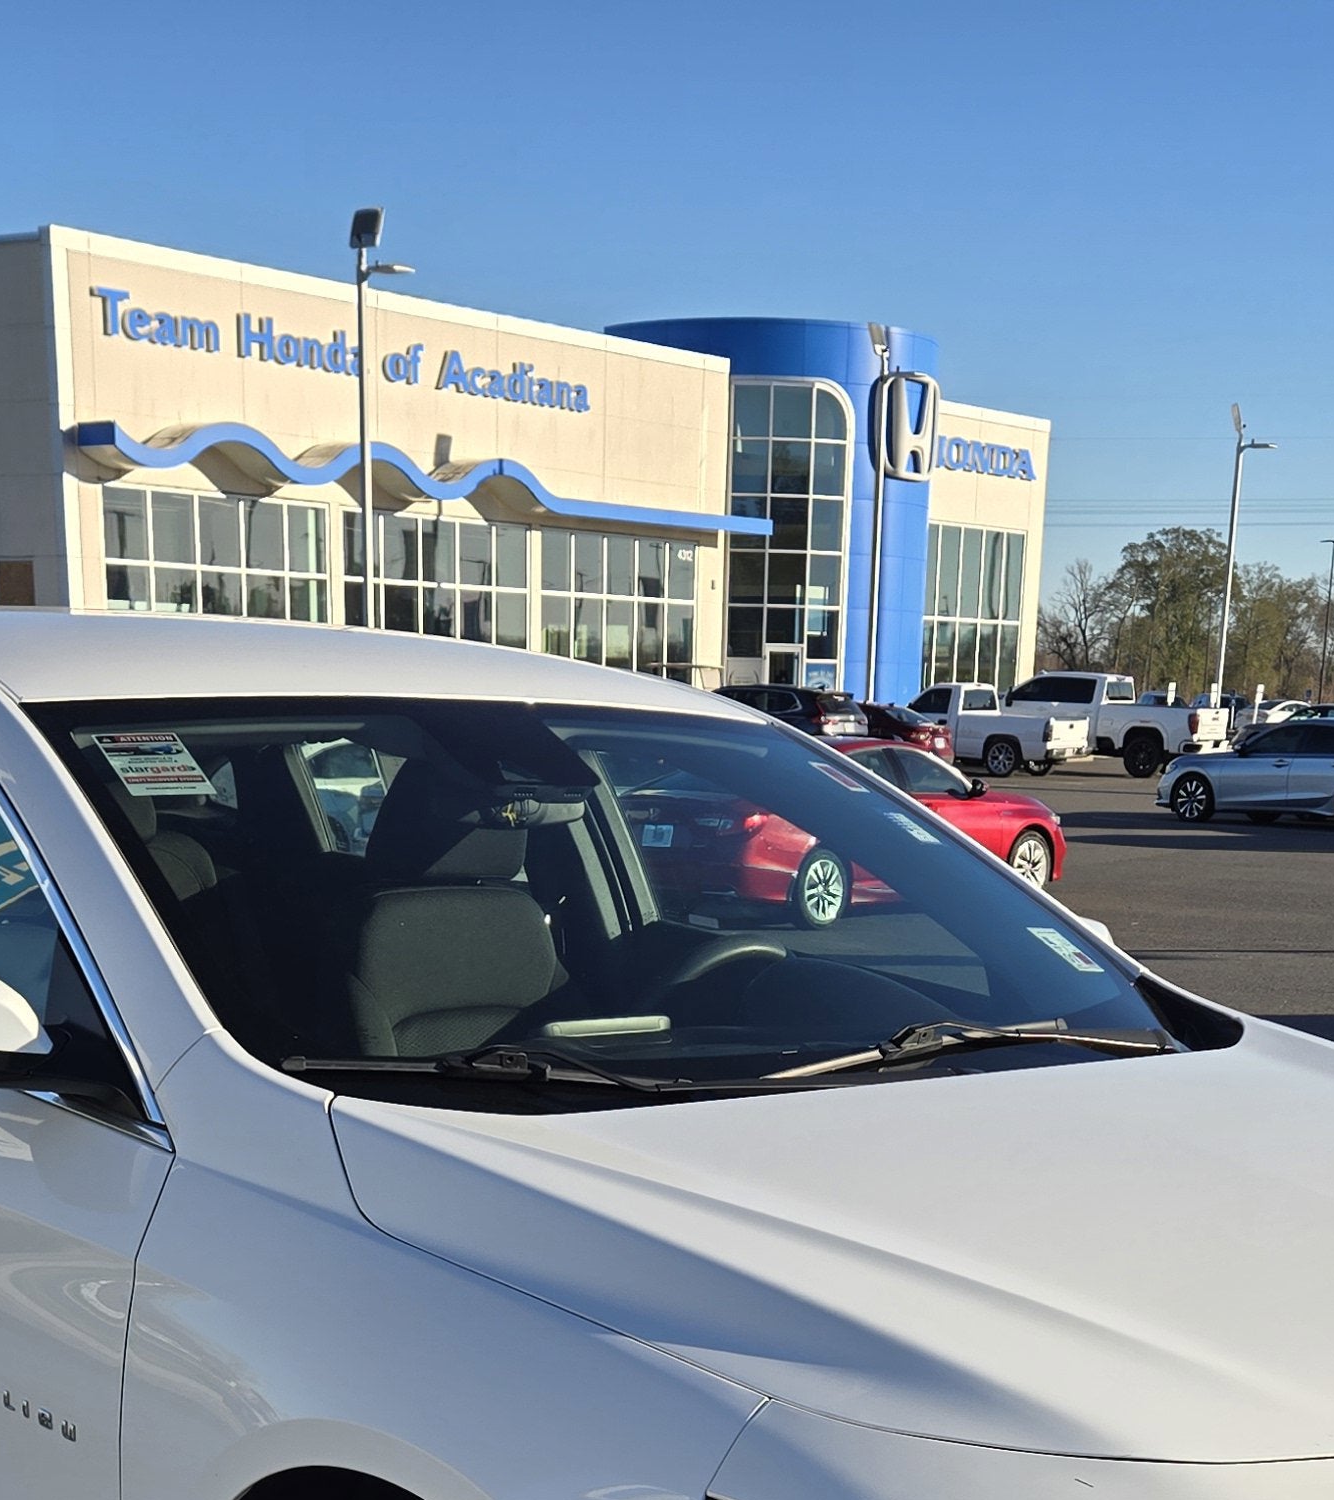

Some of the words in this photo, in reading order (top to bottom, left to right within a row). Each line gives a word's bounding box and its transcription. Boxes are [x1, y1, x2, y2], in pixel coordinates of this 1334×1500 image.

[90, 286, 220, 352] Team
[383, 344, 423, 385] of
[437, 350, 590, 412] Acadiana
